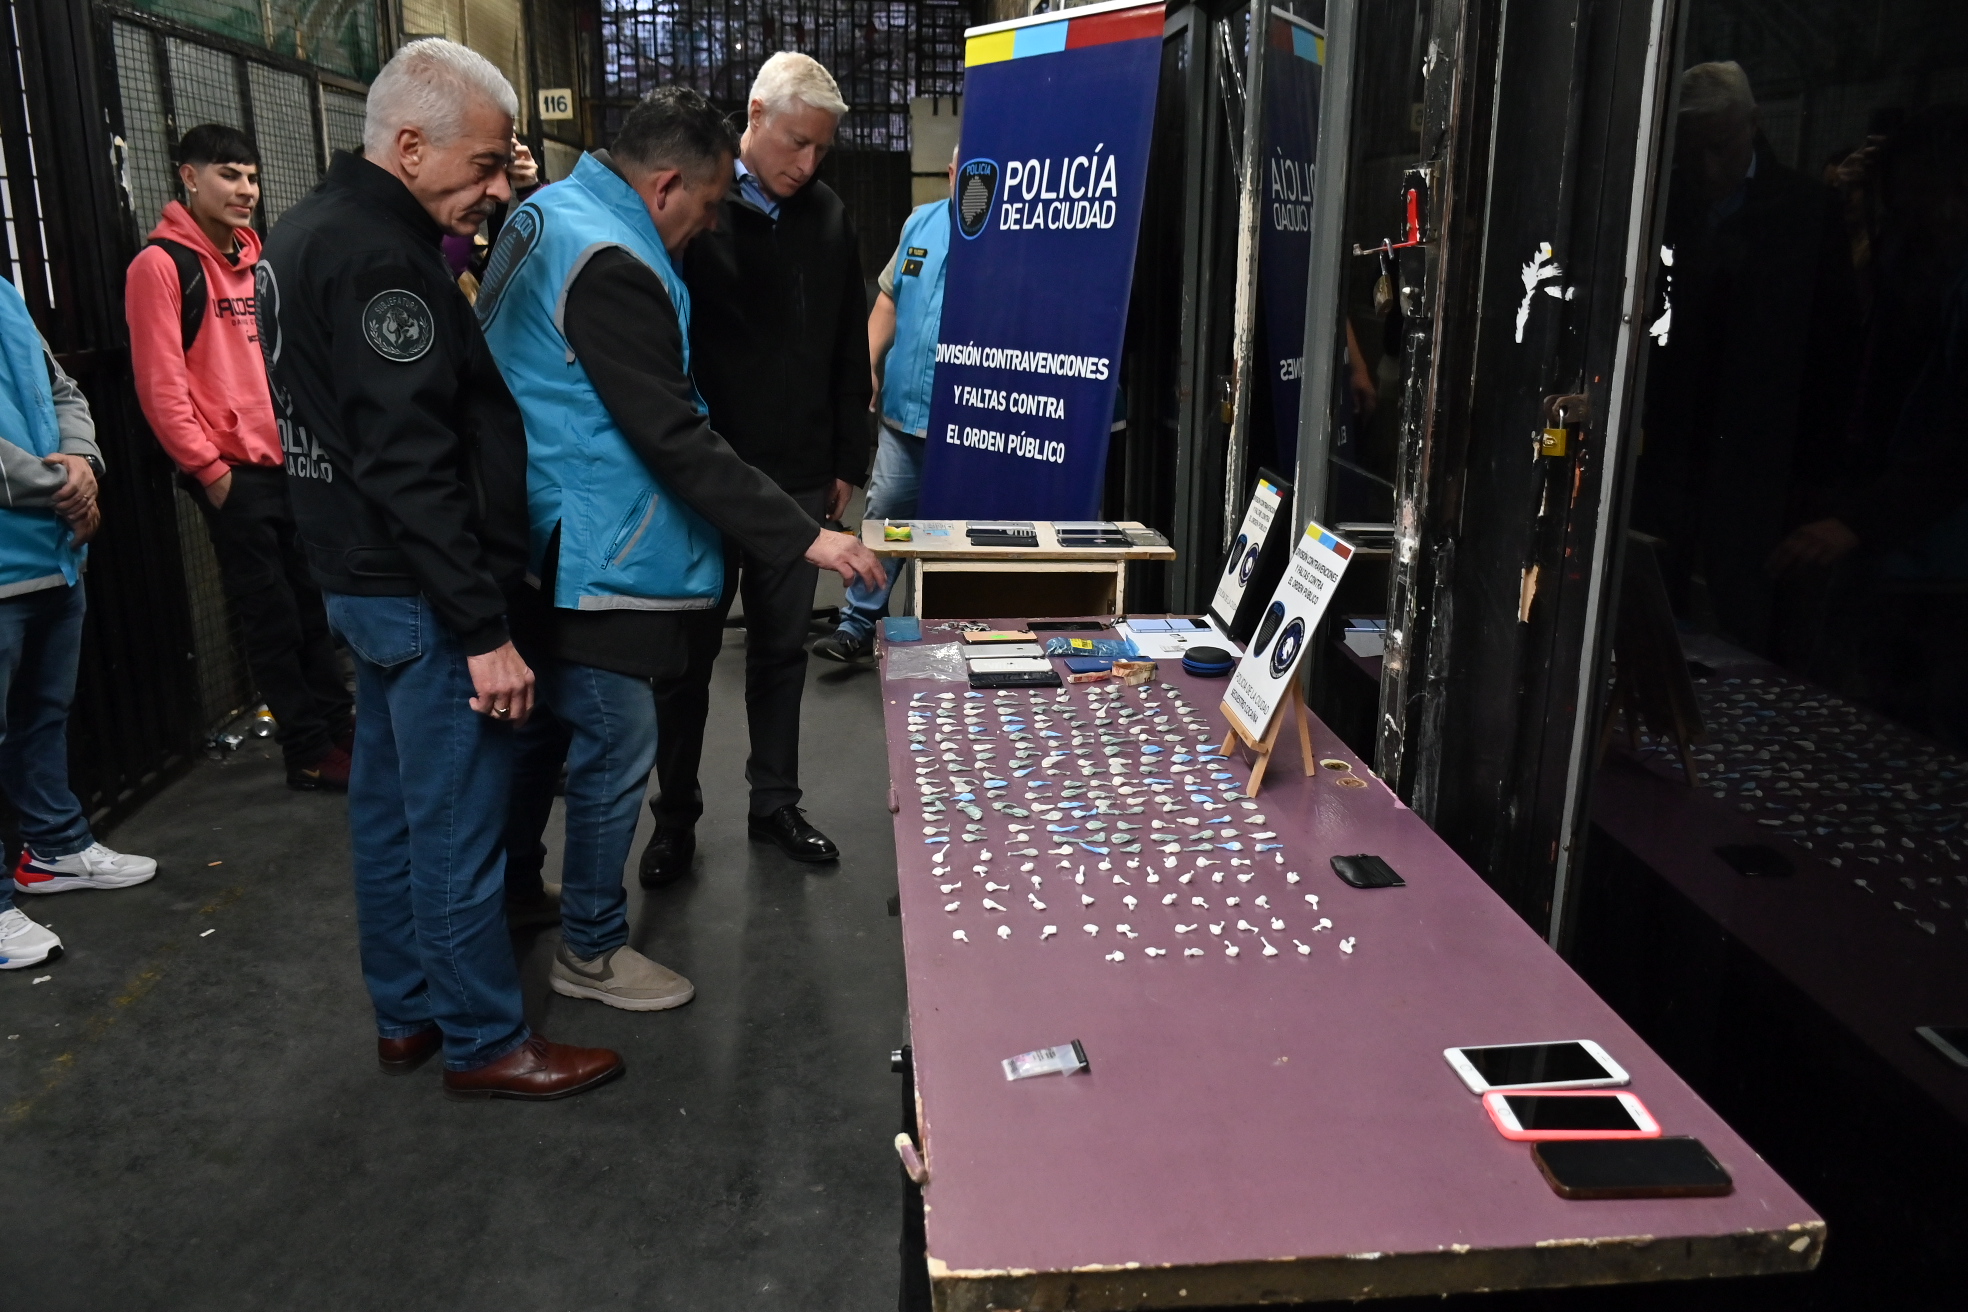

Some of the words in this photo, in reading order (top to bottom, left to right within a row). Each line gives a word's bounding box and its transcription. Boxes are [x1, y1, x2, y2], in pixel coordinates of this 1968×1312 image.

[544, 95, 568, 113] 116
[1004, 143, 1117, 201] POLICÍA
[1000, 203, 1022, 230] DE
[1022, 202, 1044, 230] LA
[1048, 200, 1116, 230] CIUDAD
[935, 341, 982, 366] DIVISIÓN
[982, 348, 1110, 380] CONTRAVENCIONES
[954, 385, 962, 404] Y
[962, 386, 1006, 412] FALTAS
[1010, 392, 1064, 420] CONTRA
[946, 424, 960, 445] EL
[963, 426, 1006, 452] ORDEN
[1008, 431, 1064, 464] PÚBLICO
[1292, 579, 1304, 594] ORDEN
[1299, 565, 1309, 580] FALTAS
[1308, 574, 1324, 590] CONTRA
